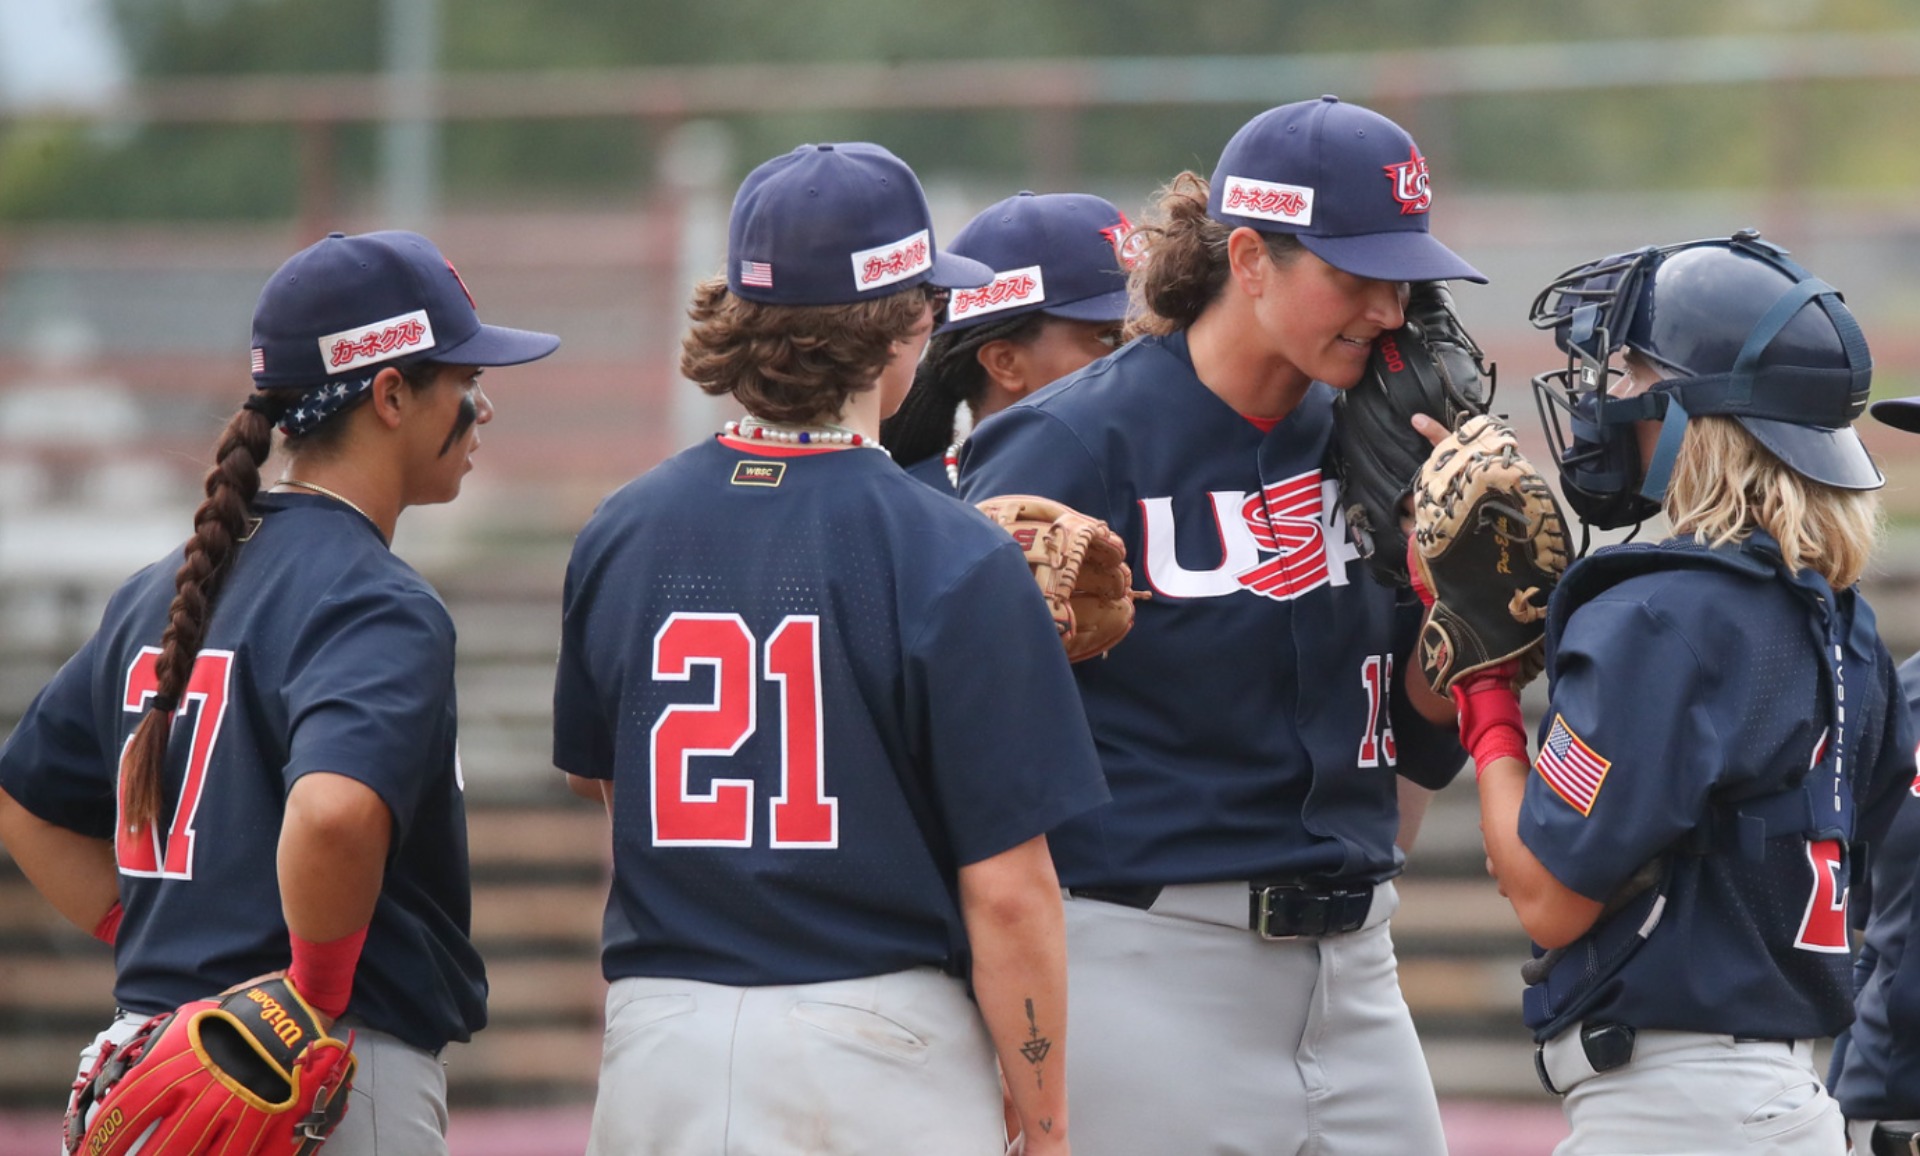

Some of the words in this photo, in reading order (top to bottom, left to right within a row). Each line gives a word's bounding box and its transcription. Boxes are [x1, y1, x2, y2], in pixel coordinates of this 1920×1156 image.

[1225, 183, 1308, 218] カーネクスト
[862, 237, 927, 284] カーネクスト
[953, 274, 1037, 316] カーネクスト
[330, 319, 426, 367] カーネクスト
[651, 612, 838, 849] 21
[246, 986, 303, 1049] Wilson
